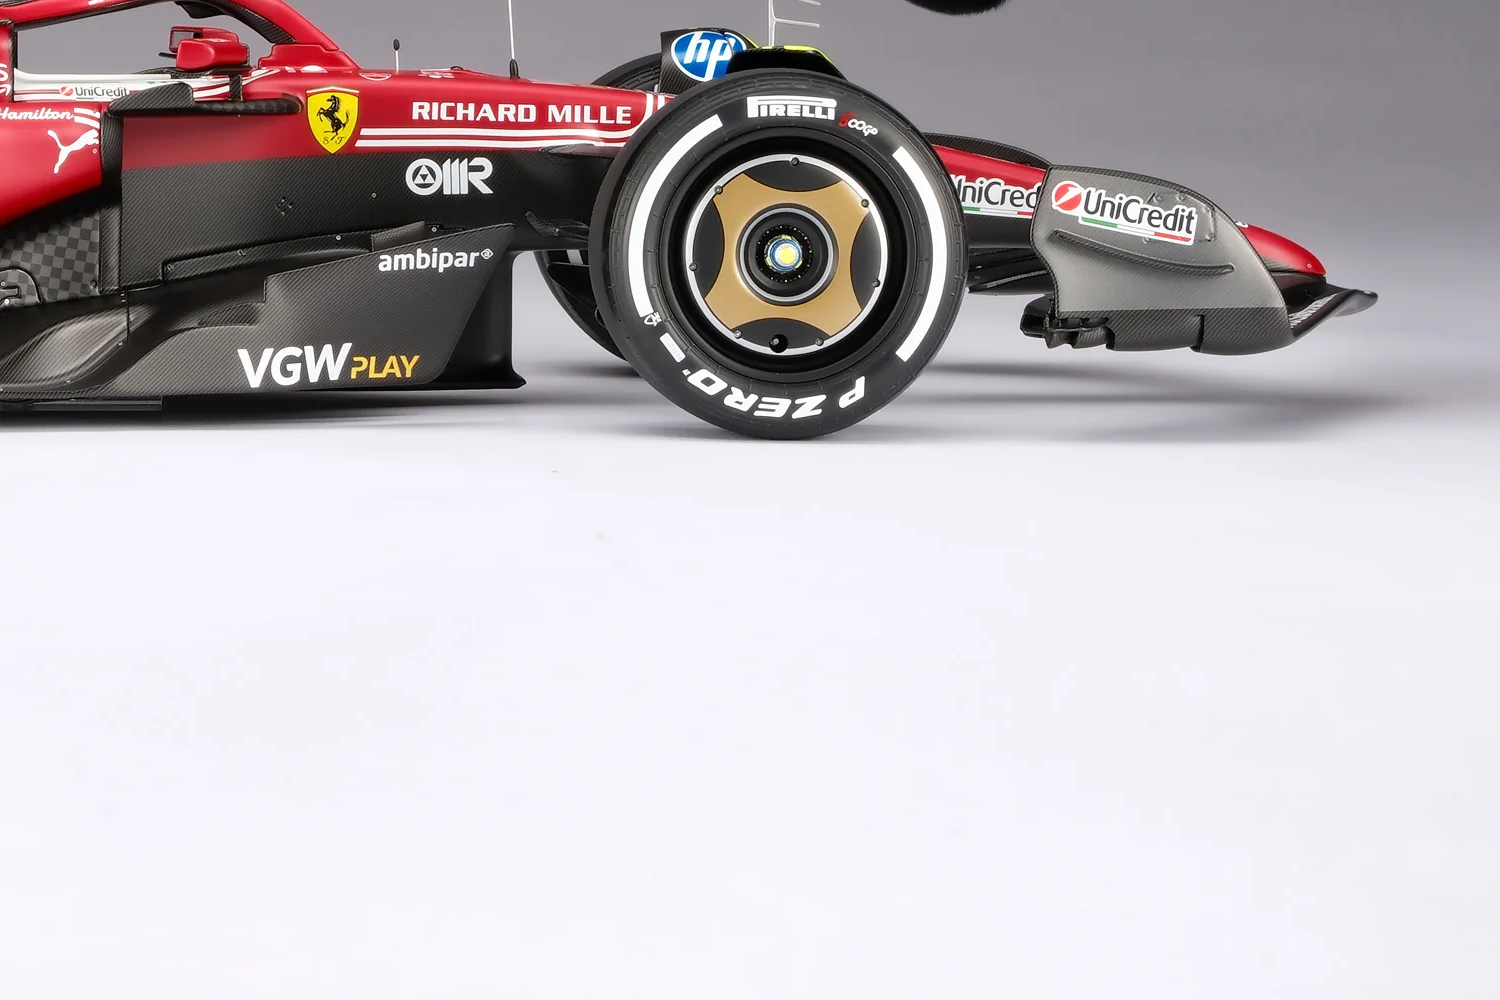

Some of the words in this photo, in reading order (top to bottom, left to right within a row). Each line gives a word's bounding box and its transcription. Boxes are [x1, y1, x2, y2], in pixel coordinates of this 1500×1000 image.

[683, 31, 736, 82] hp
[75, 86, 129, 98] UniCredit
[746, 95, 838, 121] PIRELLI
[412, 101, 537, 123] RICHARD
[548, 104, 632, 125] MILLE
[1083, 189, 1196, 235] UniCredit
[378, 247, 480, 273] ambipar
[237, 342, 353, 389] VGW
[350, 355, 420, 380] PLAY
[687, 368, 827, 419] ZERO
[838, 375, 866, 409] P
